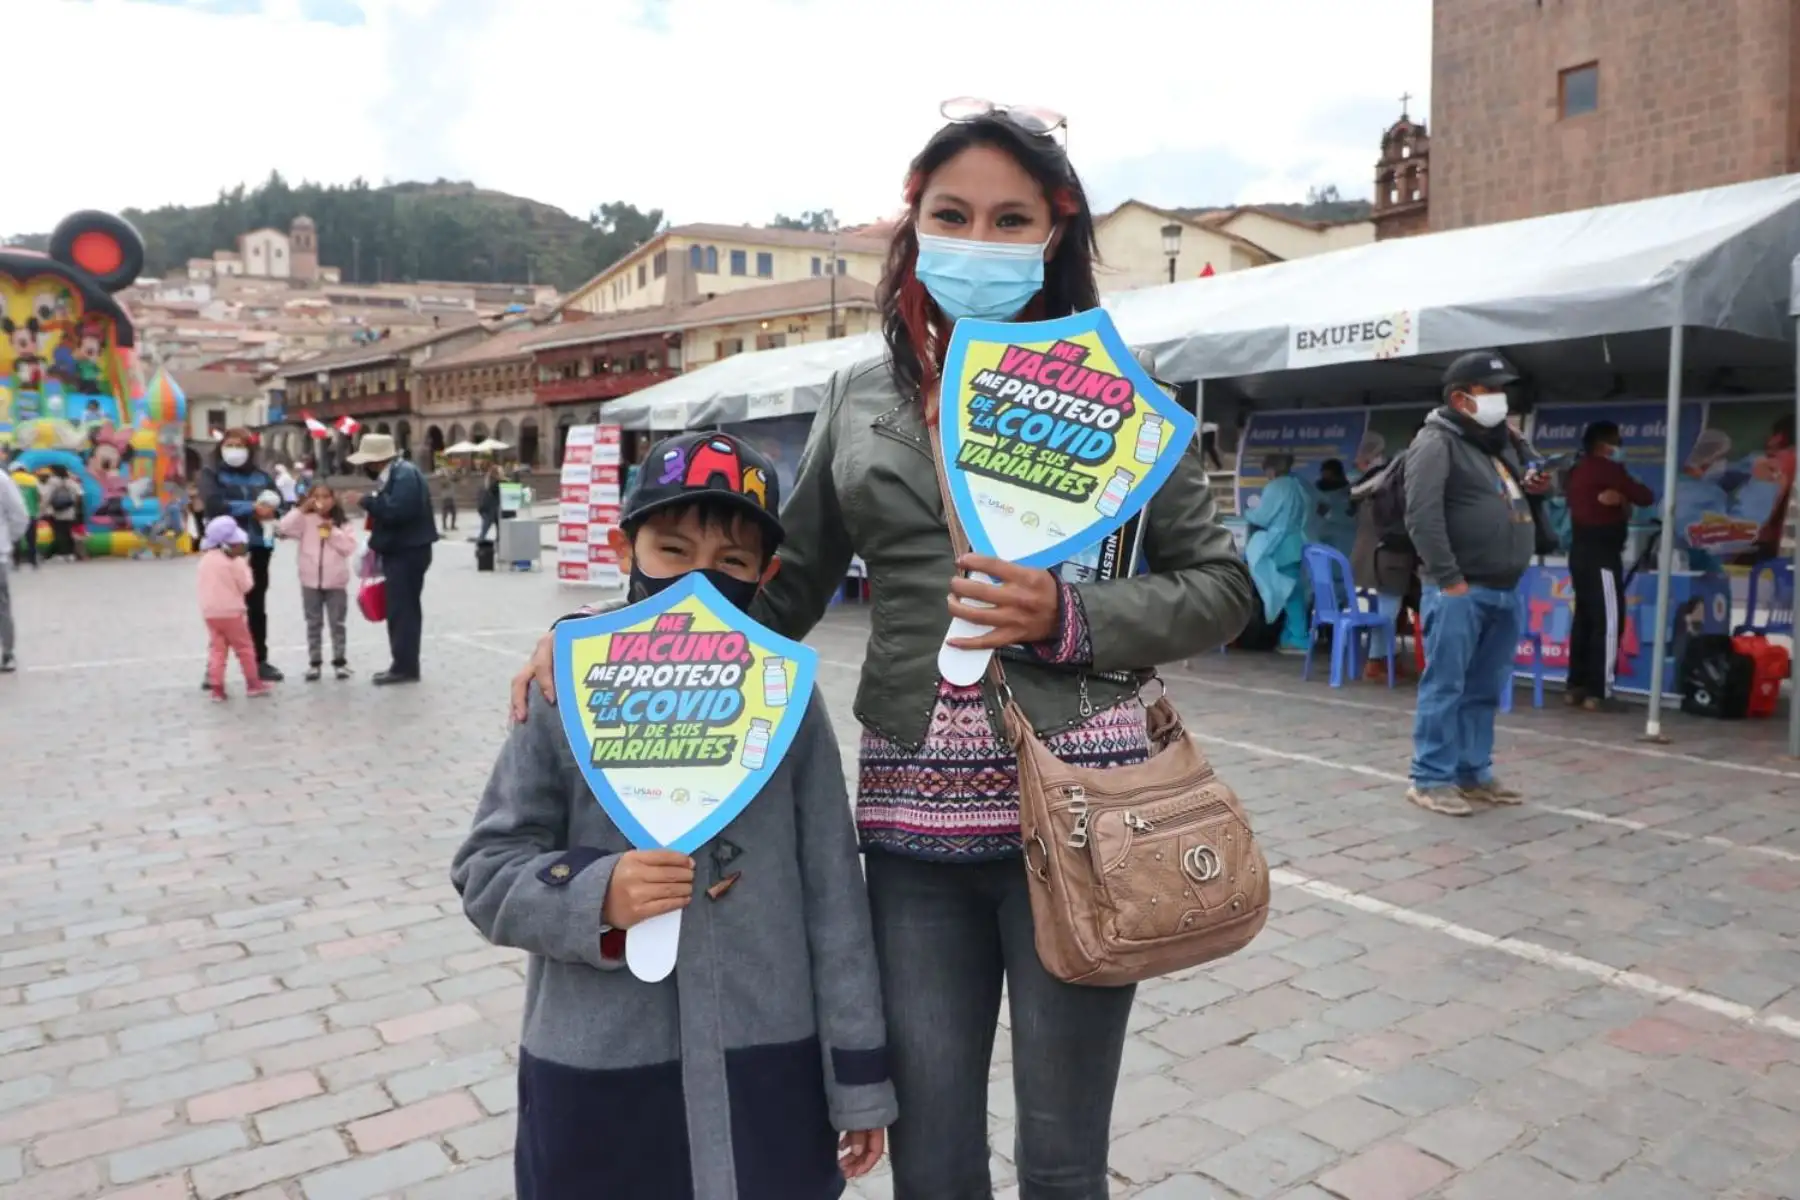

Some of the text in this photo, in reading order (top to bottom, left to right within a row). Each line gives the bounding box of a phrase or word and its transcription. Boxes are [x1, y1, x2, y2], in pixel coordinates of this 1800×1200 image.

[1296, 319, 1392, 350] EMUFEC
[1051, 341, 1084, 361] ME
[974, 371, 1120, 428] ME PROTEJO
[971, 396, 1114, 460] DE LA COVID
[996, 437, 1071, 467] Y DE SUS
[959, 442, 1097, 496] VARIANTES
[655, 614, 686, 632] ME
[588, 664, 742, 687] ME PROTEJO
[590, 689, 742, 723] DE LA COVID
[625, 723, 701, 737] Y DE SUS
[594, 738, 731, 762] VARIANTES
